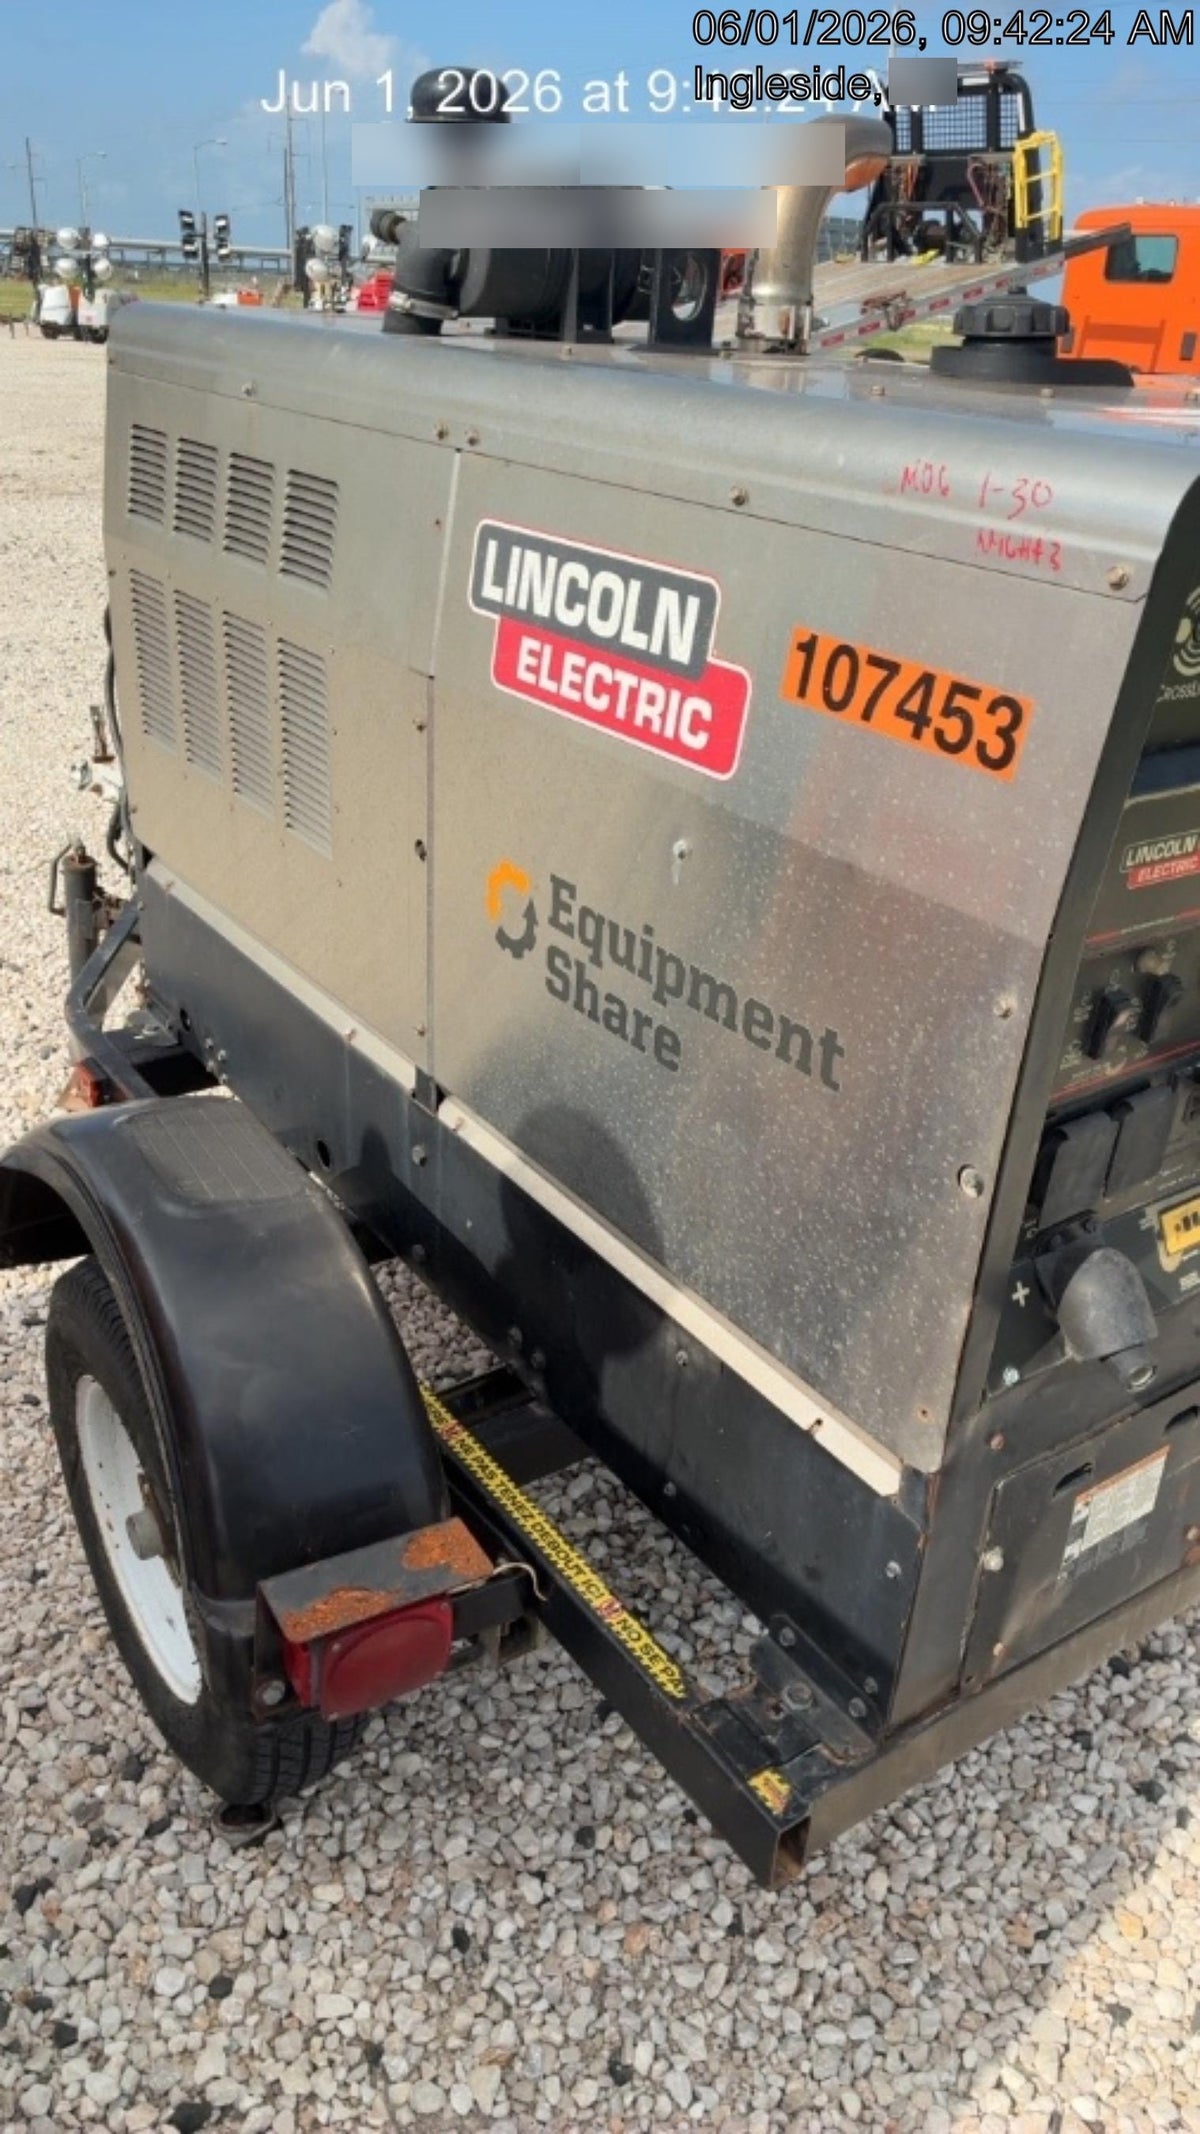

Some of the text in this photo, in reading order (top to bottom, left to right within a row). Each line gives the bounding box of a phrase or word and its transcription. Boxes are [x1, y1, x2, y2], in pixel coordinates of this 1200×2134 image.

[481, 540, 701, 665] LINCOLN
[516, 635, 713, 751] ELECTRIC
[796, 632, 1024, 772] 107453
[1125, 833, 1198, 867] LINCOLN
[545, 944, 683, 1073] Share
[547, 873, 846, 1092] Equipment
[615, 1616, 643, 1643] NO
[639, 1642, 664, 1667] SE
